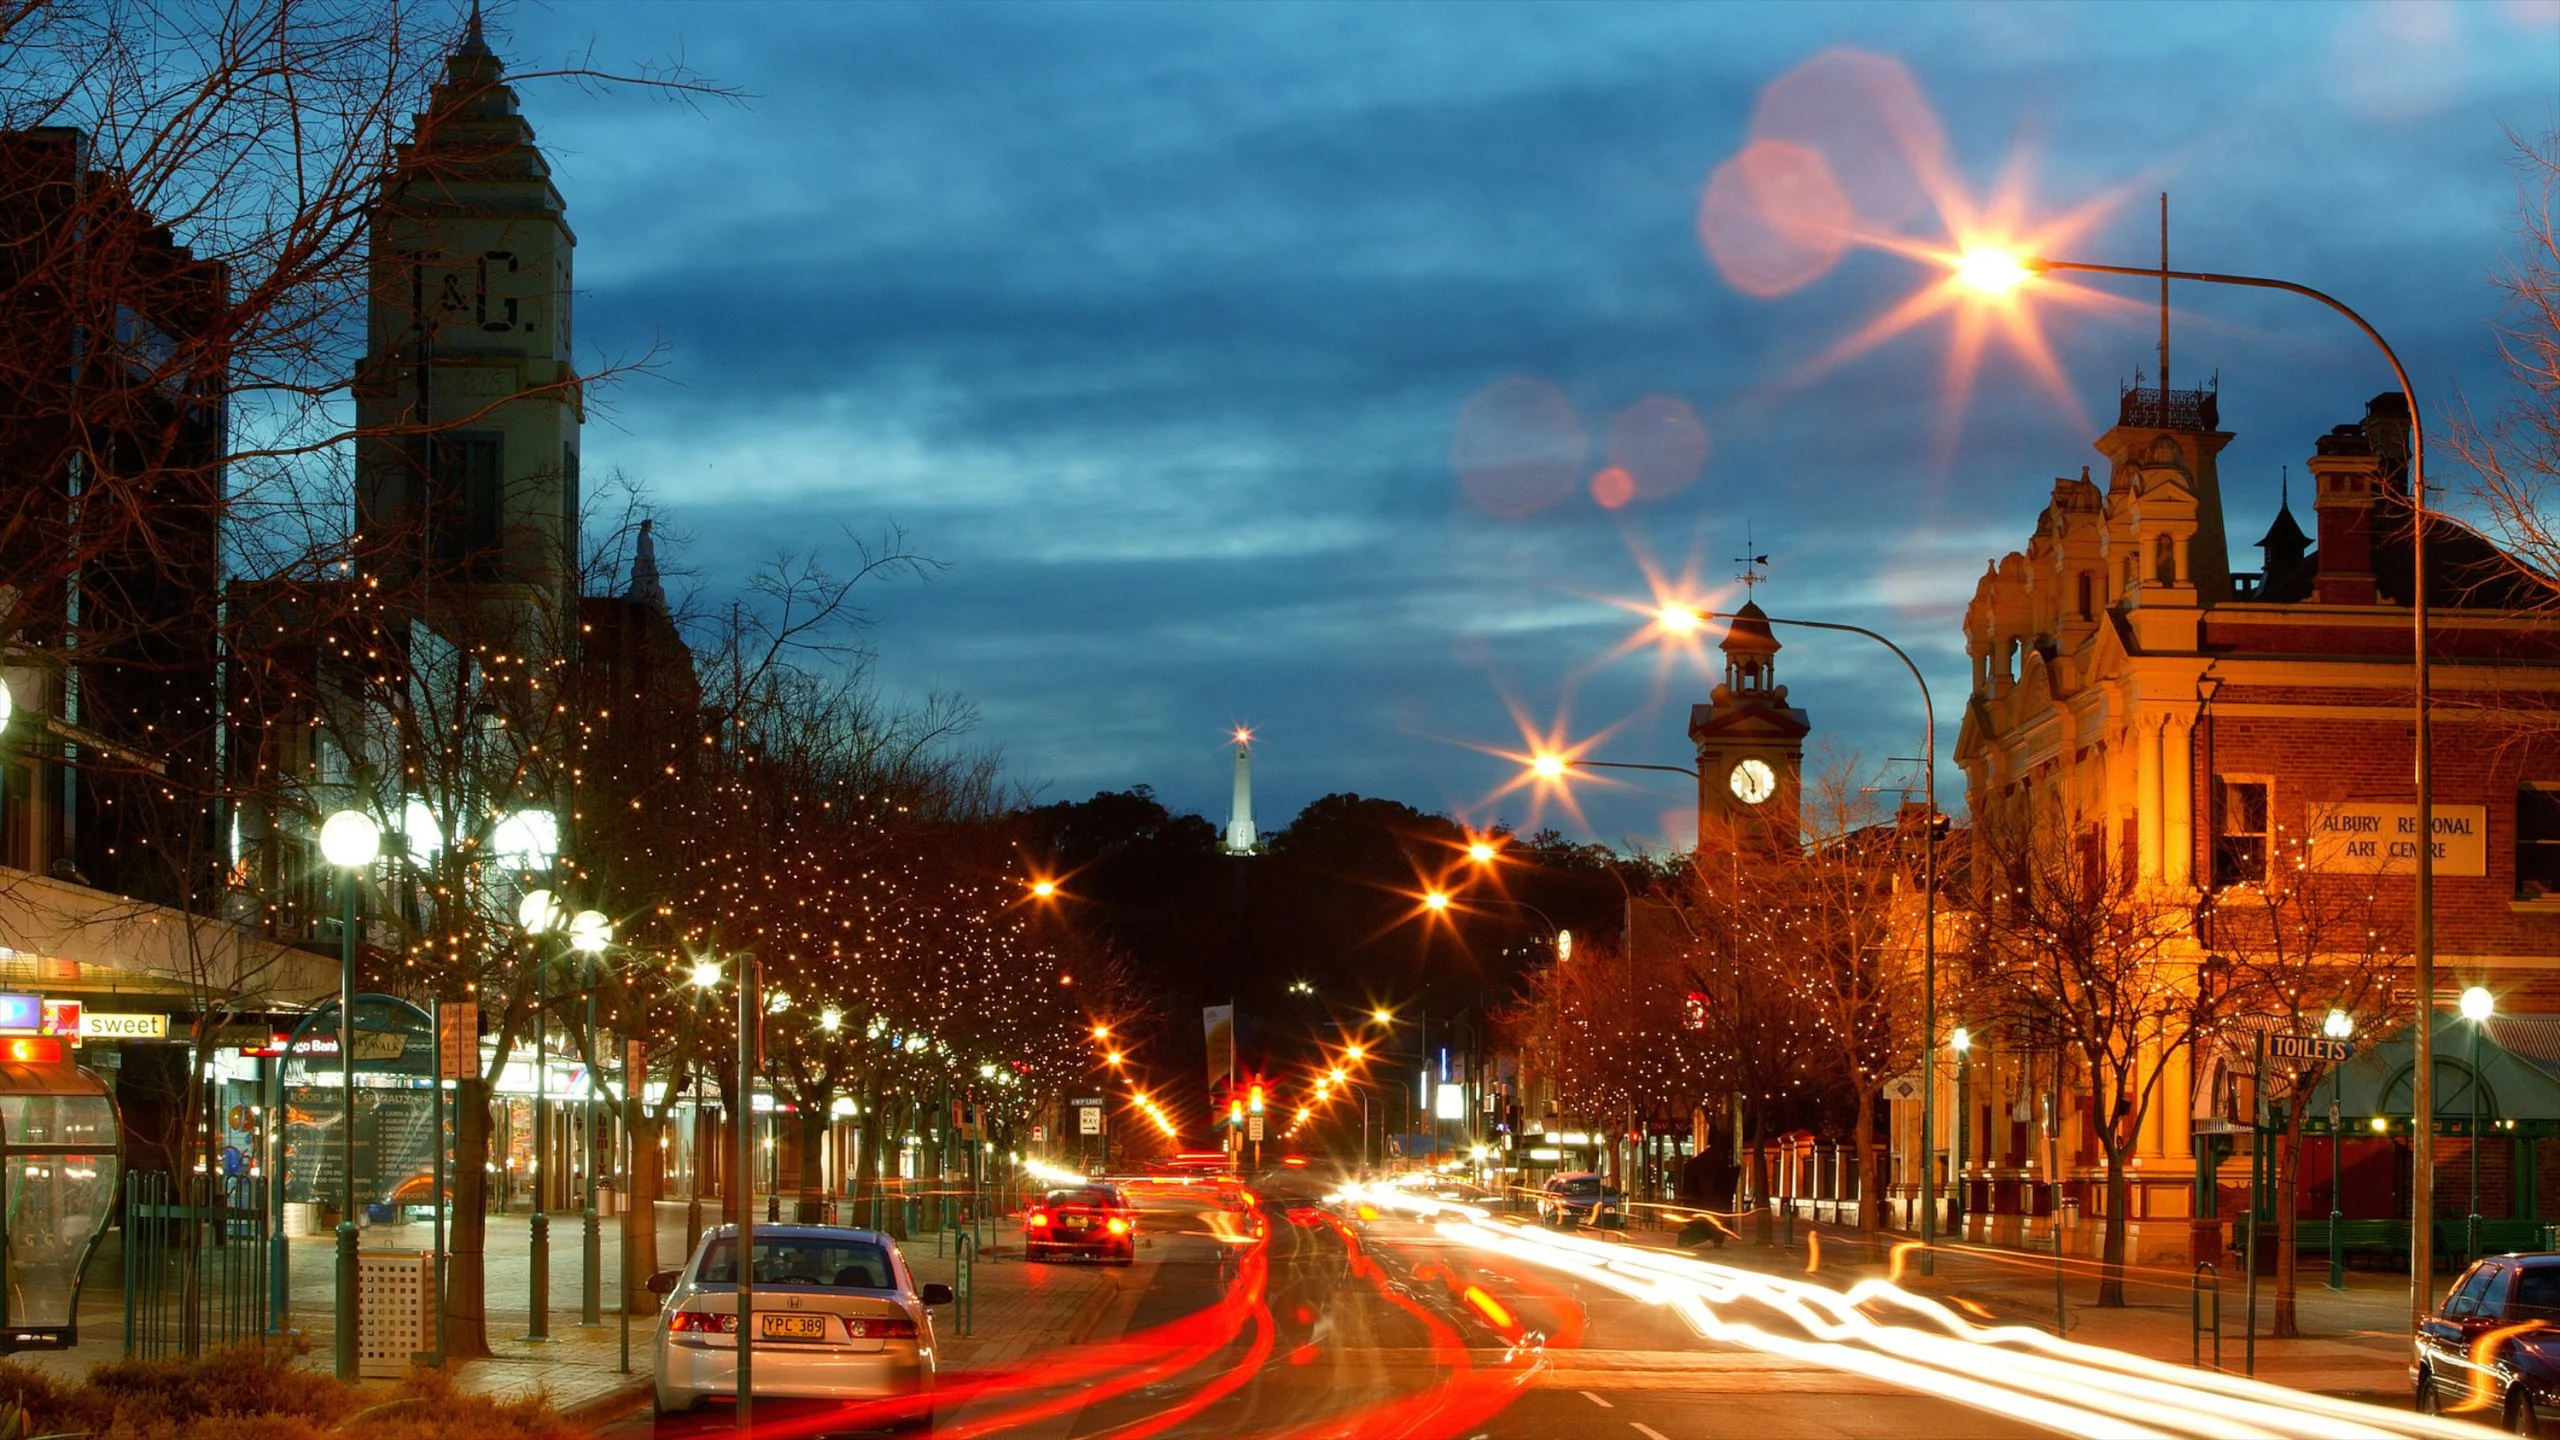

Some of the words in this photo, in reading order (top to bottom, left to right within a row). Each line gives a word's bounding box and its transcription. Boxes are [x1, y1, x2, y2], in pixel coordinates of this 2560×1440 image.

[2322, 816, 2382, 832] ALBURY
[2398, 817, 2473, 834] REONAL
[2346, 841, 2378, 856] ART
[2389, 842, 2446, 858] CENRE
[91, 1017, 158, 1034] sweet
[2275, 1037, 2346, 1060] TOILETS
[766, 1317, 792, 1332] YPC
[800, 1319, 822, 1333] 389
